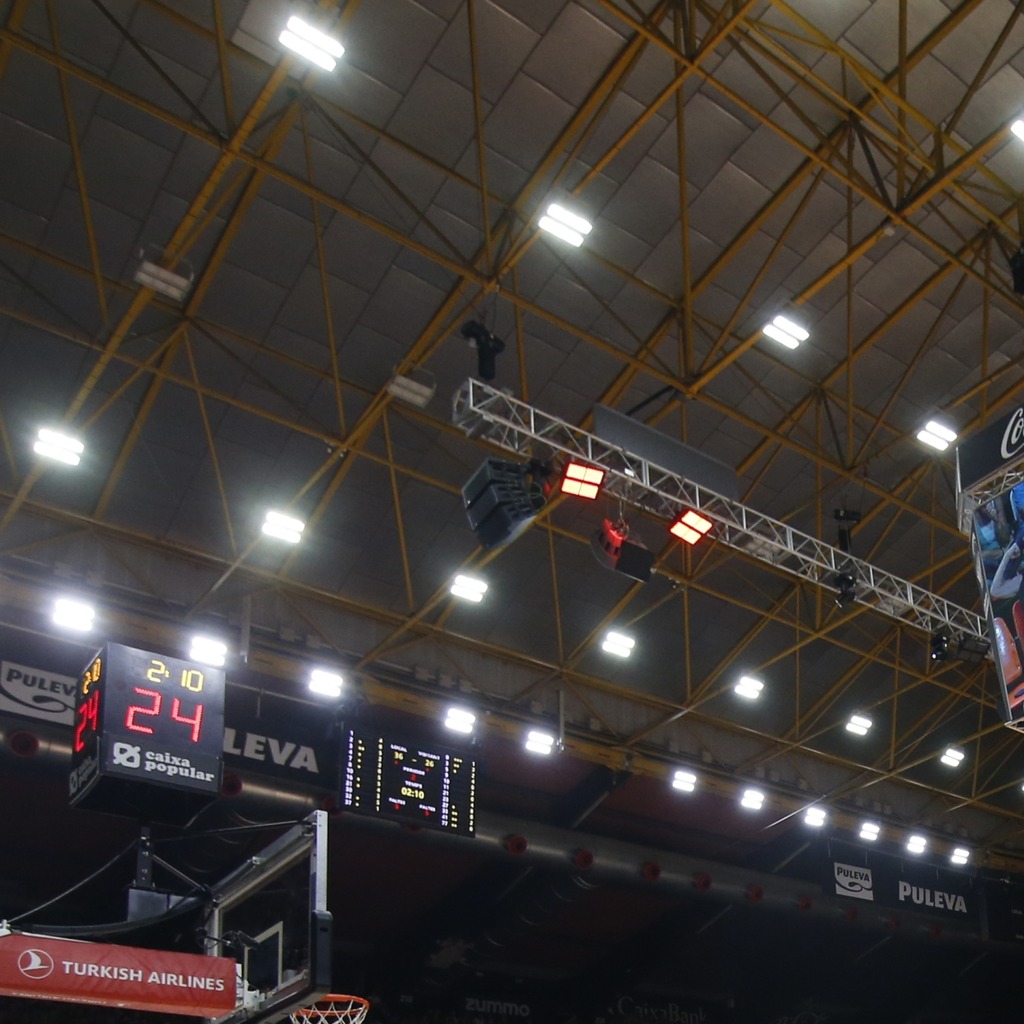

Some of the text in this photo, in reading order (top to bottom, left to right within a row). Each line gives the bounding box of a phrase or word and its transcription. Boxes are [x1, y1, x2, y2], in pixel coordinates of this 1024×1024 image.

[7, 668, 77, 697] PULEV
[125, 687, 204, 743] 24
[145, 749, 191, 768] caixa
[224, 727, 319, 773] LEVA
[144, 760, 215, 783] popular
[401, 787, 425, 799] 02:10
[836, 866, 871, 882] PULEVA
[898, 881, 968, 913] PULEVA
[62, 961, 143, 982] TURKISH
[148, 971, 225, 991] AIRLINES
[465, 998, 531, 1017] zummo
